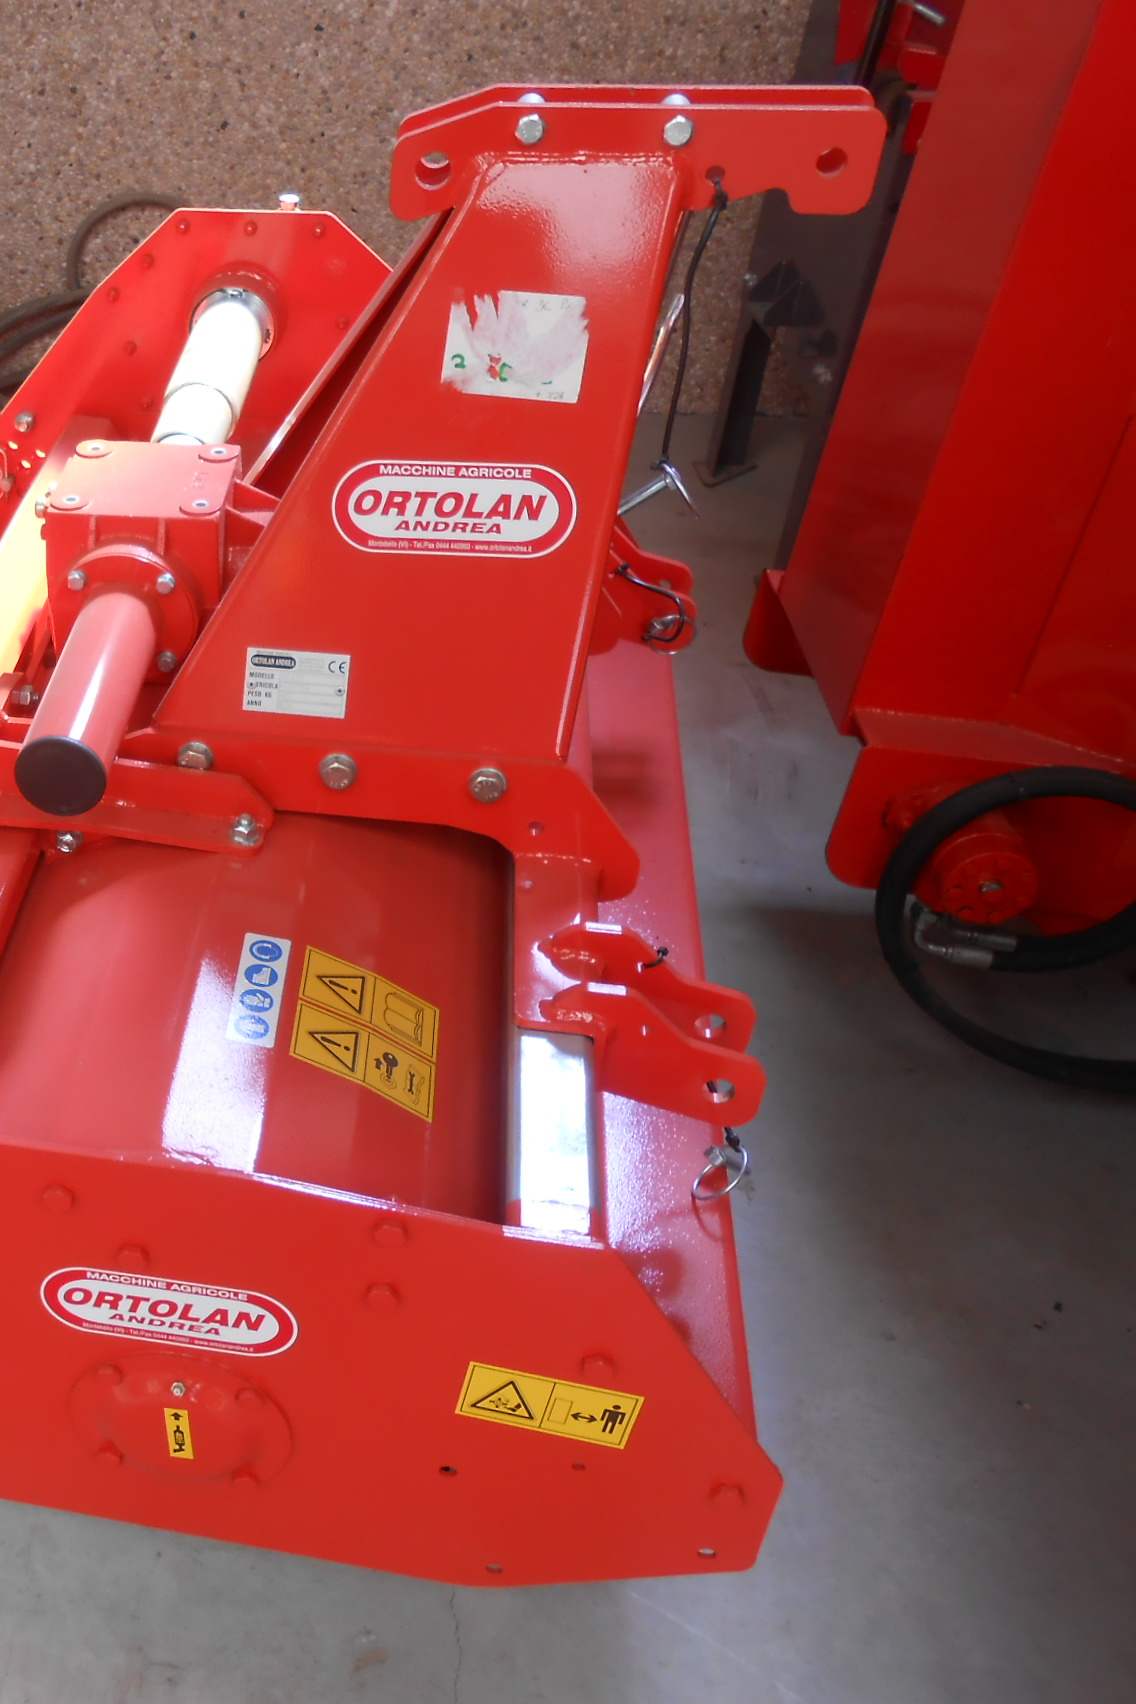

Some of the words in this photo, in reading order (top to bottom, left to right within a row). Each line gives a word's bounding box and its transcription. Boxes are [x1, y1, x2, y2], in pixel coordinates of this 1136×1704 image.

[379, 463, 456, 477] MACCHINE
[458, 467, 532, 479] AGRICOLE
[353, 489, 547, 521] ORTOLAN
[394, 520, 503, 534] ANDREA
[246, 699, 262, 707] ANNO
[247, 690, 262, 698] PESO
[86, 1271, 167, 1289] MACCHINE
[170, 1283, 248, 1301] AGRICOLE
[63, 1287, 265, 1332] ORTOLAN
[108, 1313, 221, 1336] ANDREA
